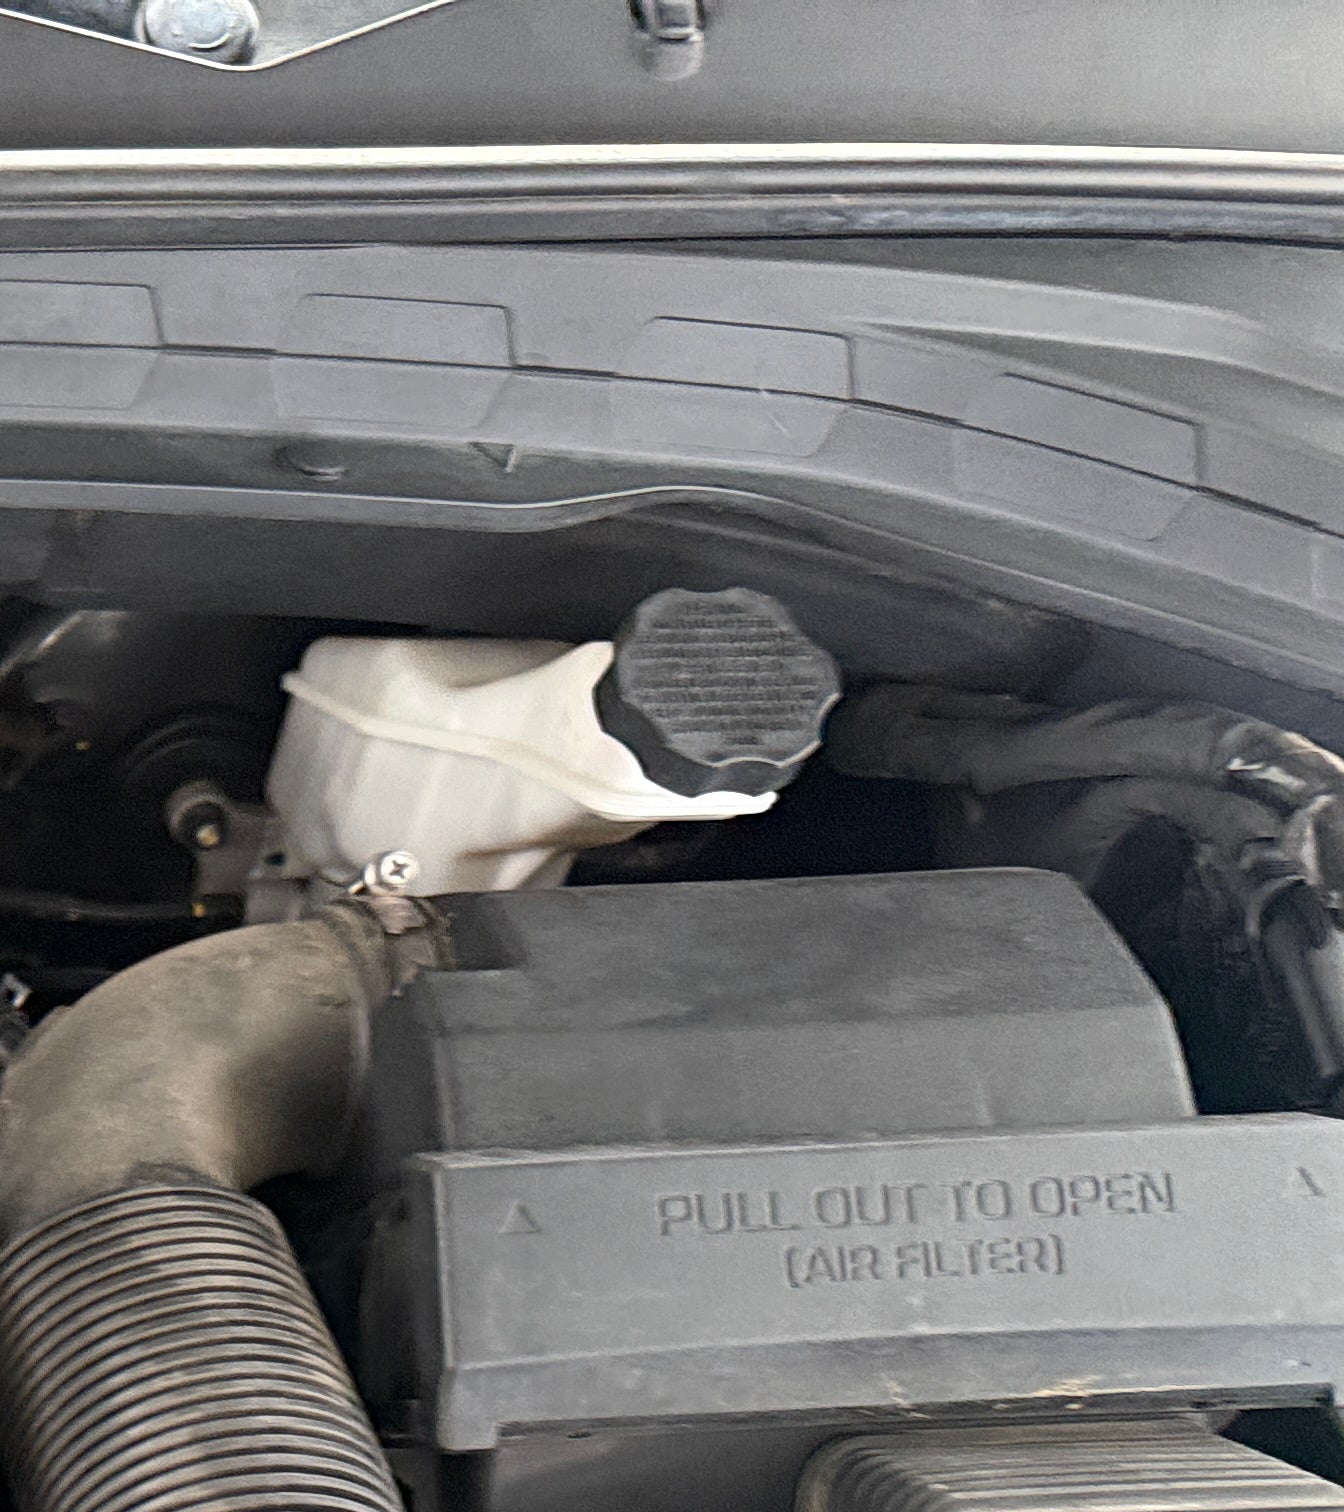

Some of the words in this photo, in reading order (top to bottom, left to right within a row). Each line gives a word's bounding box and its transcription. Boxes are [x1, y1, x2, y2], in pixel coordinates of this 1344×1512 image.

[658, 1190, 800, 1236] PULL
[814, 1182, 929, 1229] OUT
[938, 1177, 1012, 1223] TO
[1028, 1171, 1178, 1217] OPEN
